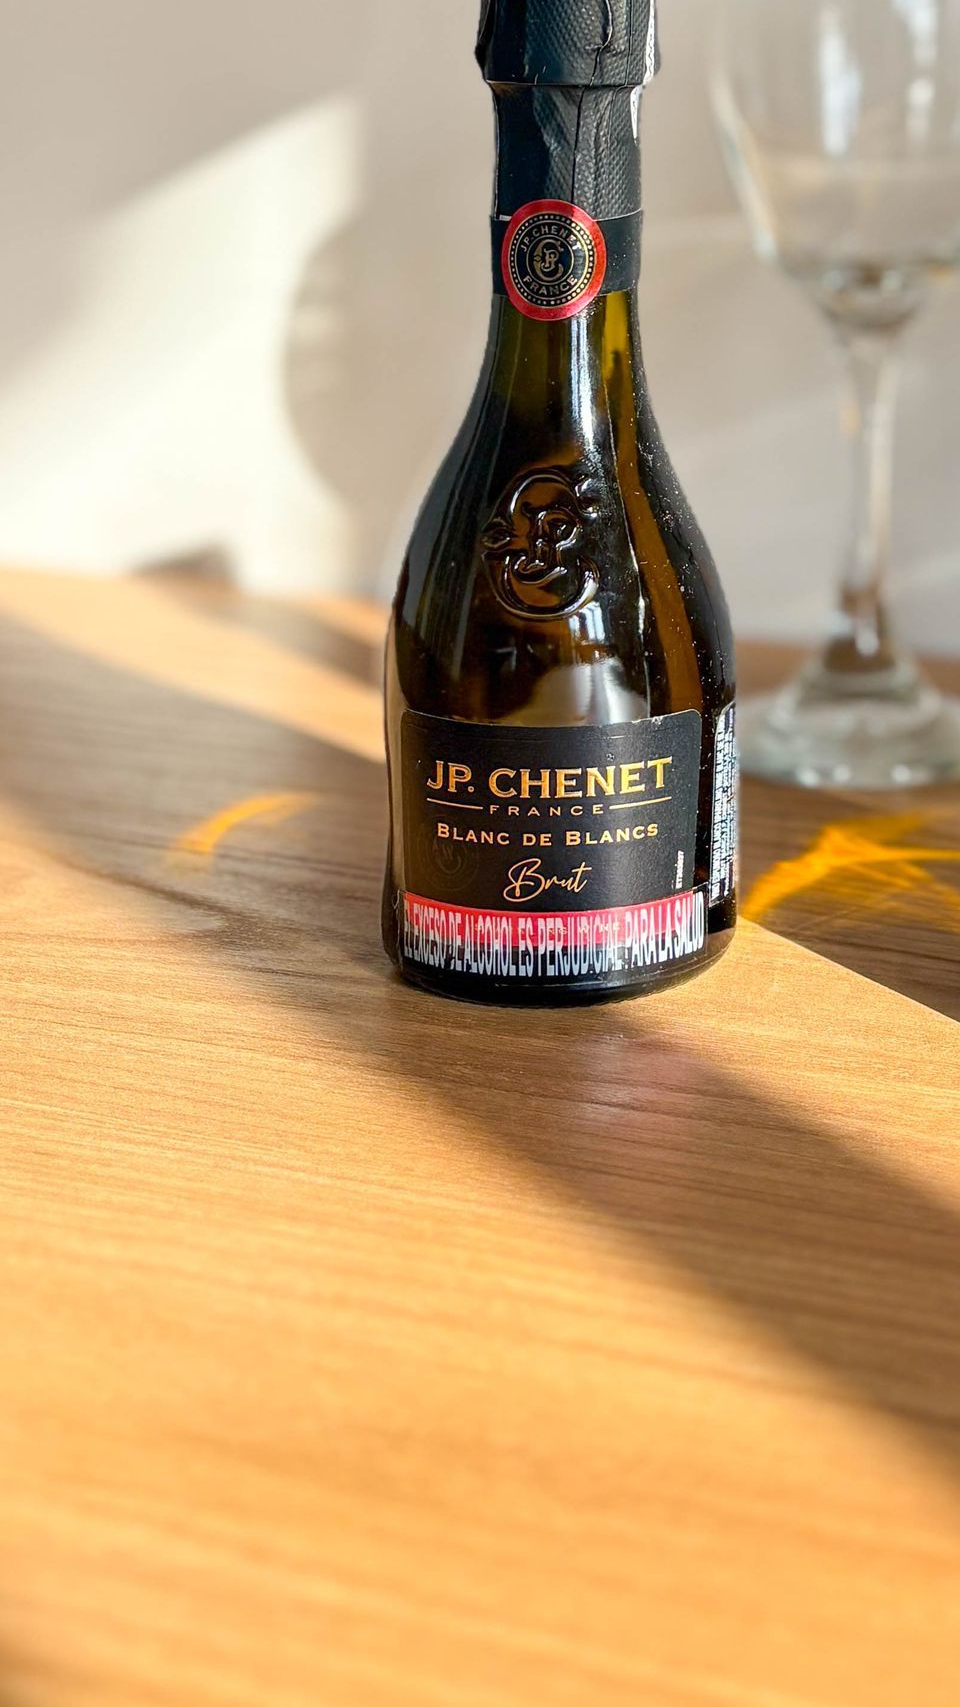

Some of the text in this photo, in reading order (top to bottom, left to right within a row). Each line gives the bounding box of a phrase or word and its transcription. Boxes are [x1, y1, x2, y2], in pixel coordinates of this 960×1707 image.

[533, 225, 582, 250] CHENET
[522, 274, 579, 296] FRANCE
[426, 756, 673, 799] JP. CHENET
[489, 804, 605, 817] FRANCE
[436, 822, 659, 847] BLANC DE BLANCS
[502, 857, 593, 902] Brut
[413, 902, 447, 970] EXCESO
[448, 910, 463, 972] DE
[463, 913, 517, 977] ALCOHOL
[518, 917, 534, 978] ES
[537, 912, 623, 978] PERJUDICIAL
[624, 907, 657, 969] PARA
[658, 901, 673, 963] LA
[674, 891, 705, 959] SALUD
